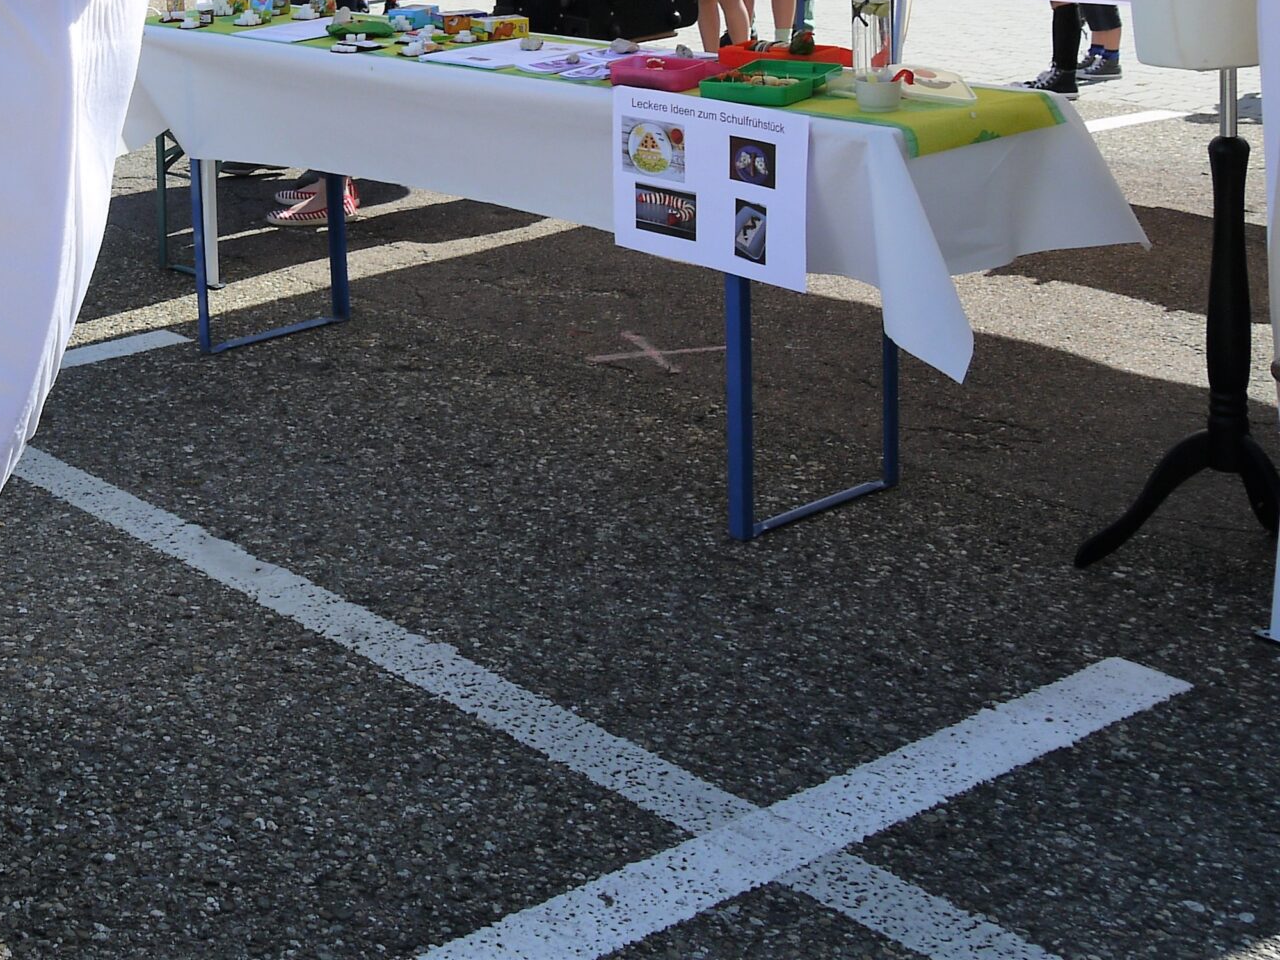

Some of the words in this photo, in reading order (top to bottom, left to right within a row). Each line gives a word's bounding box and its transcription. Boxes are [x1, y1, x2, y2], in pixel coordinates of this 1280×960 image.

[631, 97, 668, 112] Leckere
[670, 103, 695, 117] Ideen
[697, 110, 717, 121] zum
[719, 111, 785, 134] Schulfrühstück
